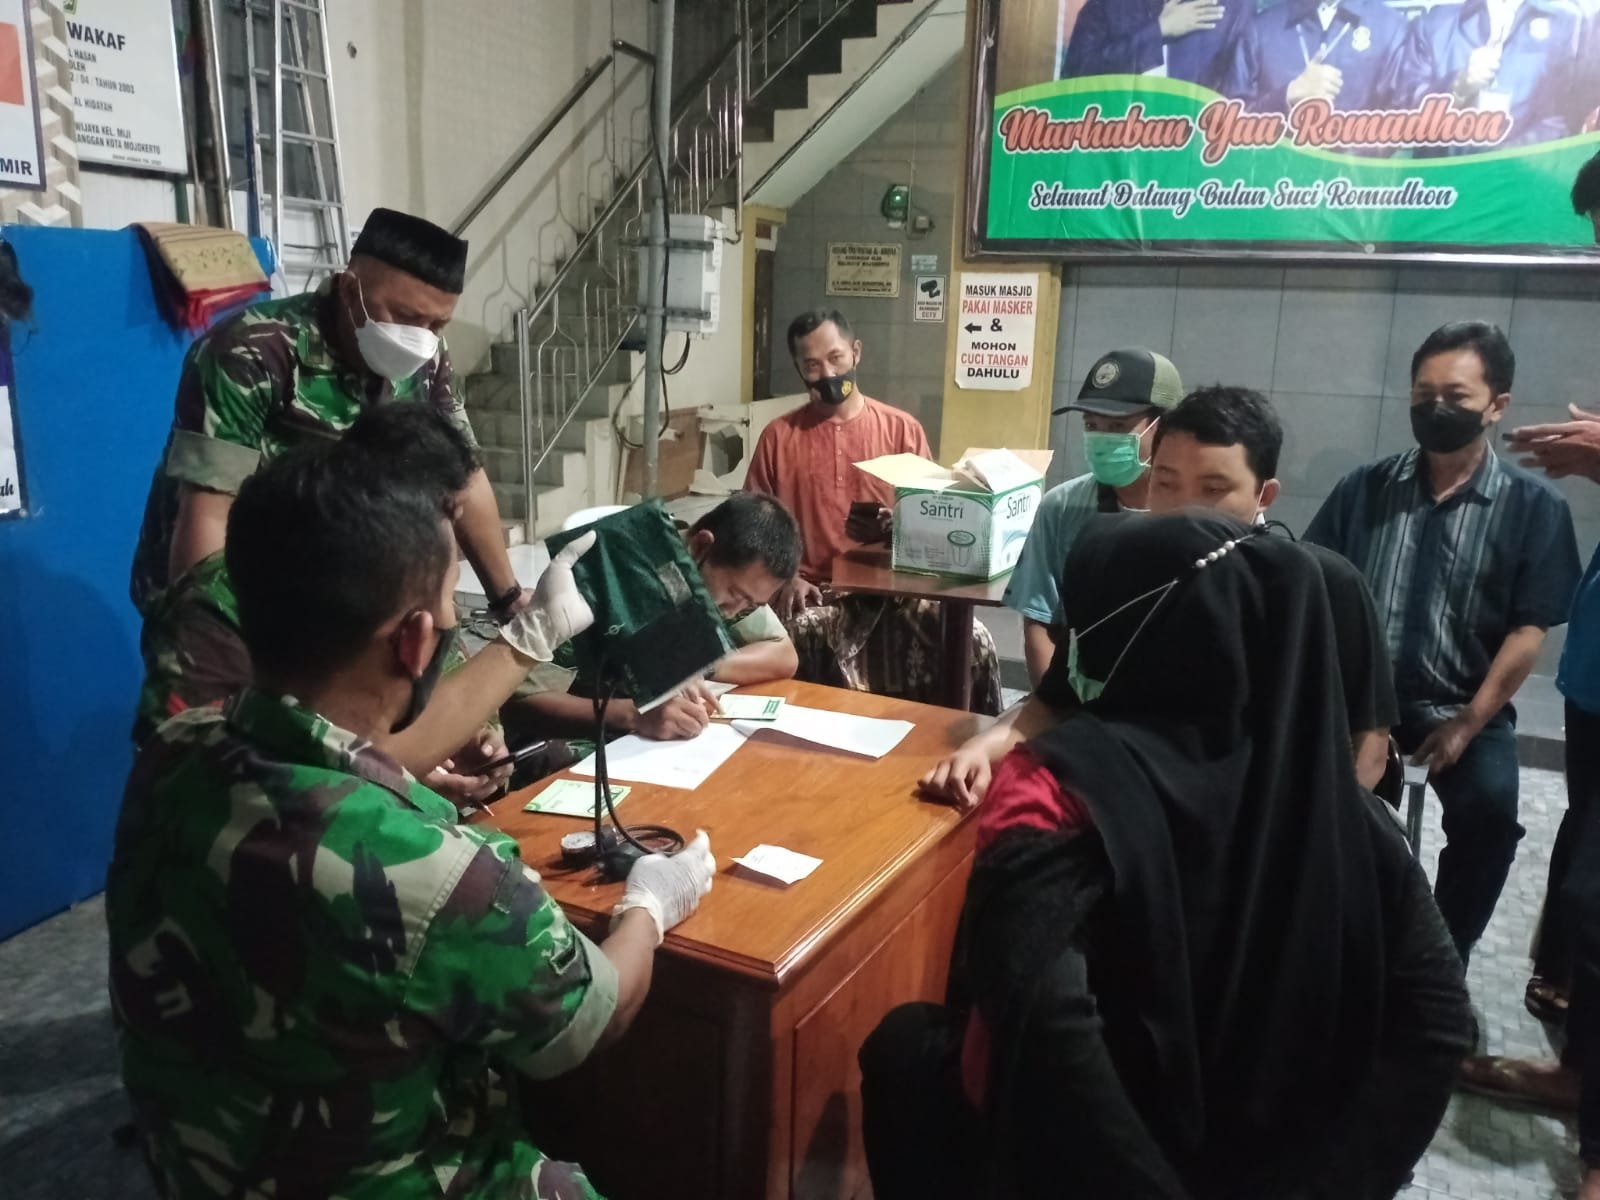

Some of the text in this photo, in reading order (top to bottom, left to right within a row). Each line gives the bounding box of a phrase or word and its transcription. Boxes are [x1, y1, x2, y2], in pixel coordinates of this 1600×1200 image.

[66, 21, 126, 51] WAKAF
[999, 95, 1510, 164] Marhaban Yaa Romadhon
[0, 157, 32, 175] MIR
[1031, 179, 1455, 216] Selamat Datang Bulan Suci Romadhon
[965, 285, 1033, 297] MASUK MASJID
[962, 300, 1033, 315] PAKAI MASKER
[990, 318, 1003, 332] &
[971, 342, 1016, 351] MOHON
[961, 353, 1028, 366] CUCI TANGAN
[967, 367, 1020, 379] DAHULU
[920, 500, 964, 519] Santri
